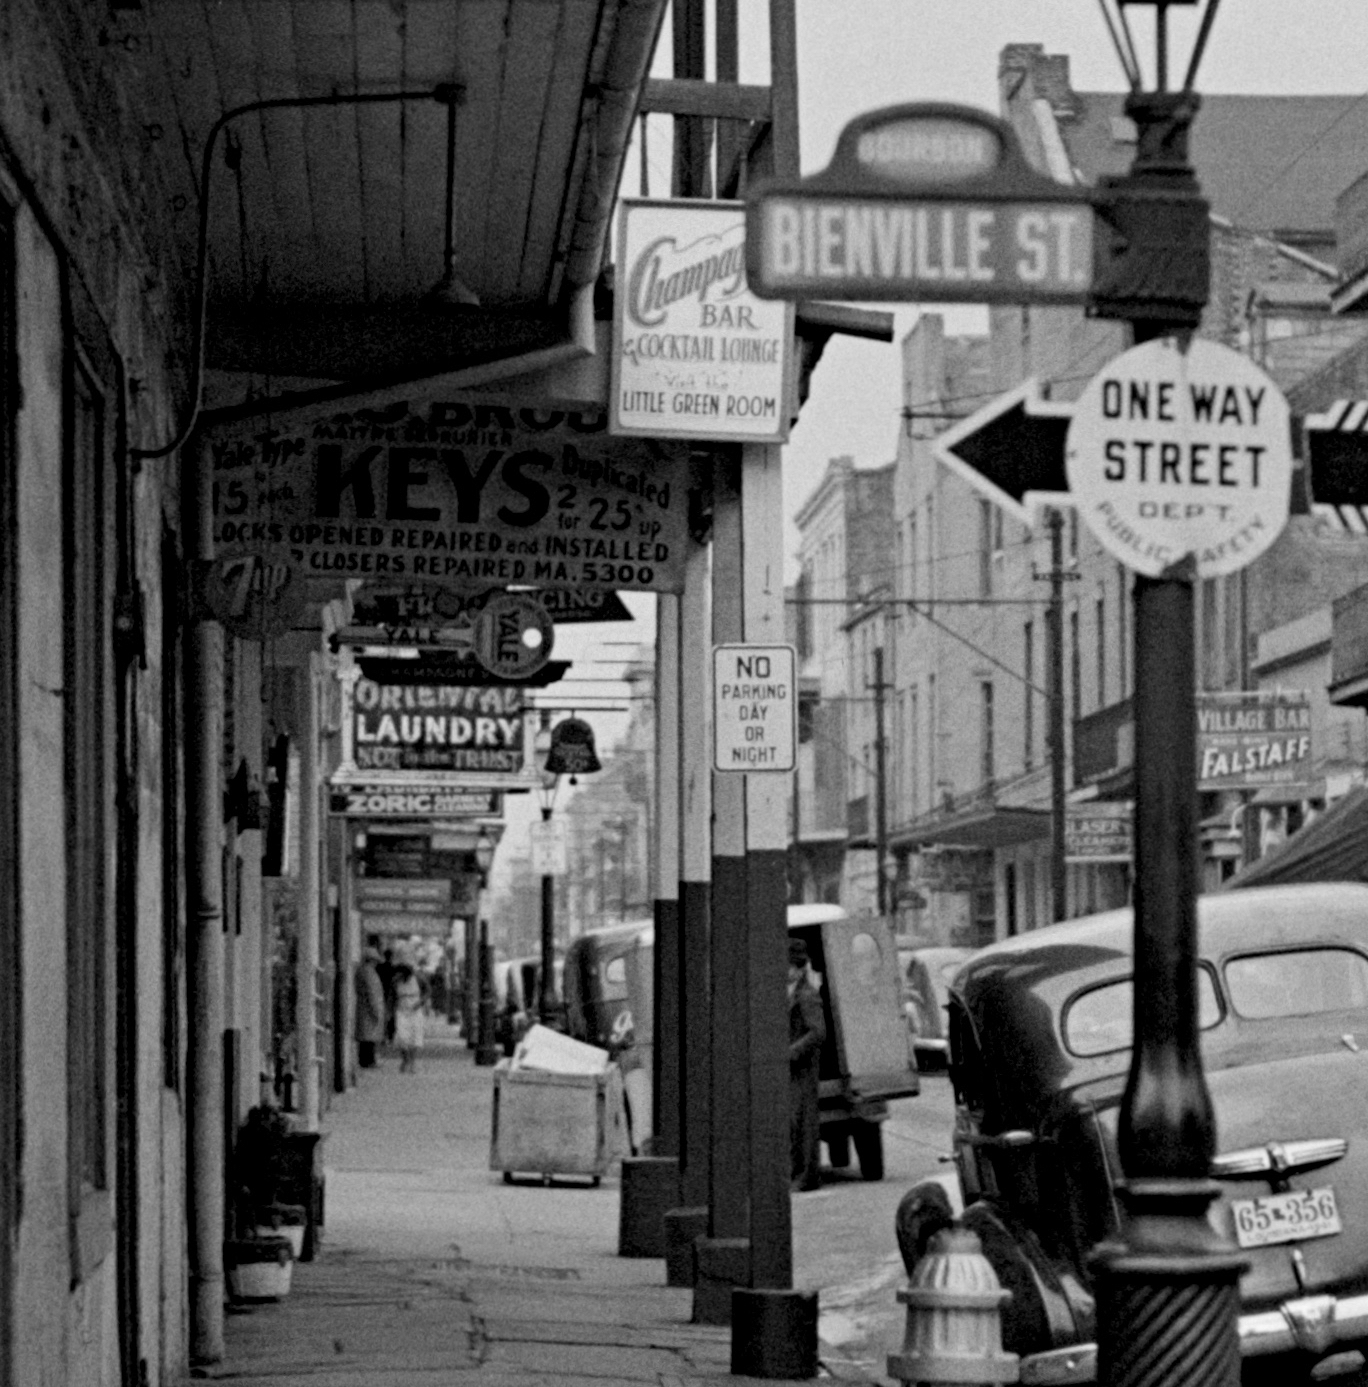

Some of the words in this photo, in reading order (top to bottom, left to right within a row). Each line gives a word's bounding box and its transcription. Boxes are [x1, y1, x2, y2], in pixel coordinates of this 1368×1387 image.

[771, 206, 996, 281] BIENVILLE
[1016, 206, 1087, 282] ST.
[698, 303, 764, 331] BAR
[637, 332, 717, 363] COCKTAIL
[721, 337, 781, 364] LOUNGE
[623, 390, 666, 414] LITTLE
[672, 392, 720, 416] GREEN
[726, 395, 777, 418] ROOM
[1101, 378, 1176, 423] ONE
[1188, 383, 1267, 426] WAY
[561, 443, 669, 510] Duplicated
[1103, 438, 1268, 489] STREET
[314, 444, 556, 528] KEYS
[557, 484, 578, 508] 2
[556, 512, 582, 532] for
[637, 519, 662, 541] up
[1095, 500, 1173, 562] PUBLIC
[1198, 512, 1265, 563] AFETY
[289, 523, 383, 547] OPENED
[390, 527, 503, 553] REPAIRED
[544, 534, 670, 563] INSTALLED
[309, 549, 405, 574] CLOSERS
[413, 553, 526, 580] REPAIRED
[534, 558, 578, 583] MA.
[581, 562, 654, 585] 5300
[498, 611, 522, 663] YALE
[736, 656, 771, 679] NO
[721, 684, 787, 700] PARKING
[739, 705, 769, 721] DAY
[1197, 709, 1266, 731] VILLAGE
[1274, 707, 1309, 729] BAR
[357, 713, 522, 745] LAUNDRY
[744, 726, 765, 742] OR
[452, 749, 524, 770] TRUST
[732, 746, 777, 763] NIGHT
[1201, 736, 1310, 780] FALSTAFF
[347, 794, 432, 813] ZORIC
